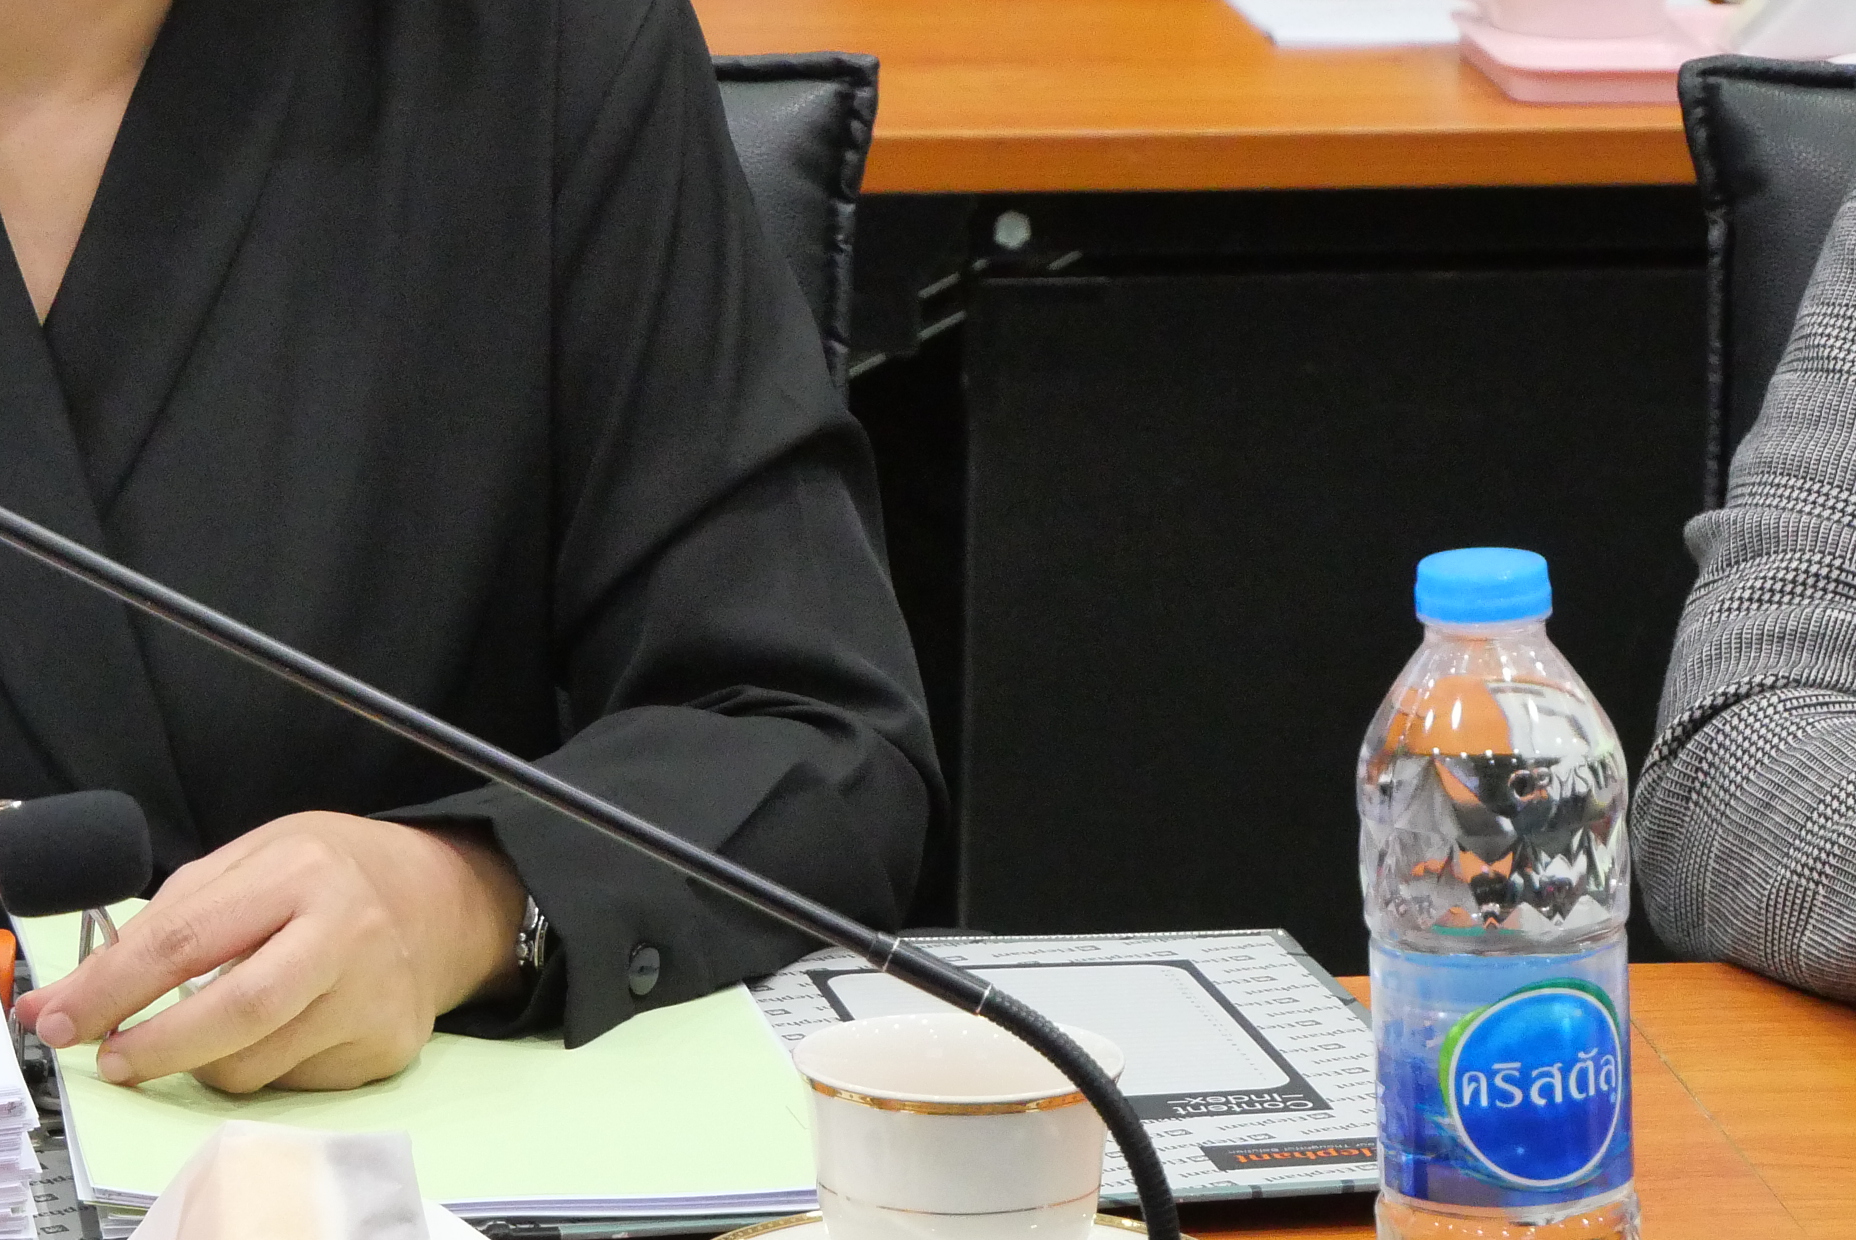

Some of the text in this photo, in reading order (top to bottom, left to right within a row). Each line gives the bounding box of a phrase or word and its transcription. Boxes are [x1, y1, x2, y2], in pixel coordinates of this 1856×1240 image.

[1460, 1047, 1618, 1109] คริสตัล
[1184, 1092, 1280, 1106] Index
[1172, 1099, 1314, 1116] Content
[1215, 1115, 1309, 1132] Elephant
[1227, 1146, 1280, 1155] Solution
[1234, 1148, 1376, 1164] lephant
[1264, 1167, 1356, 1183] Elephant
